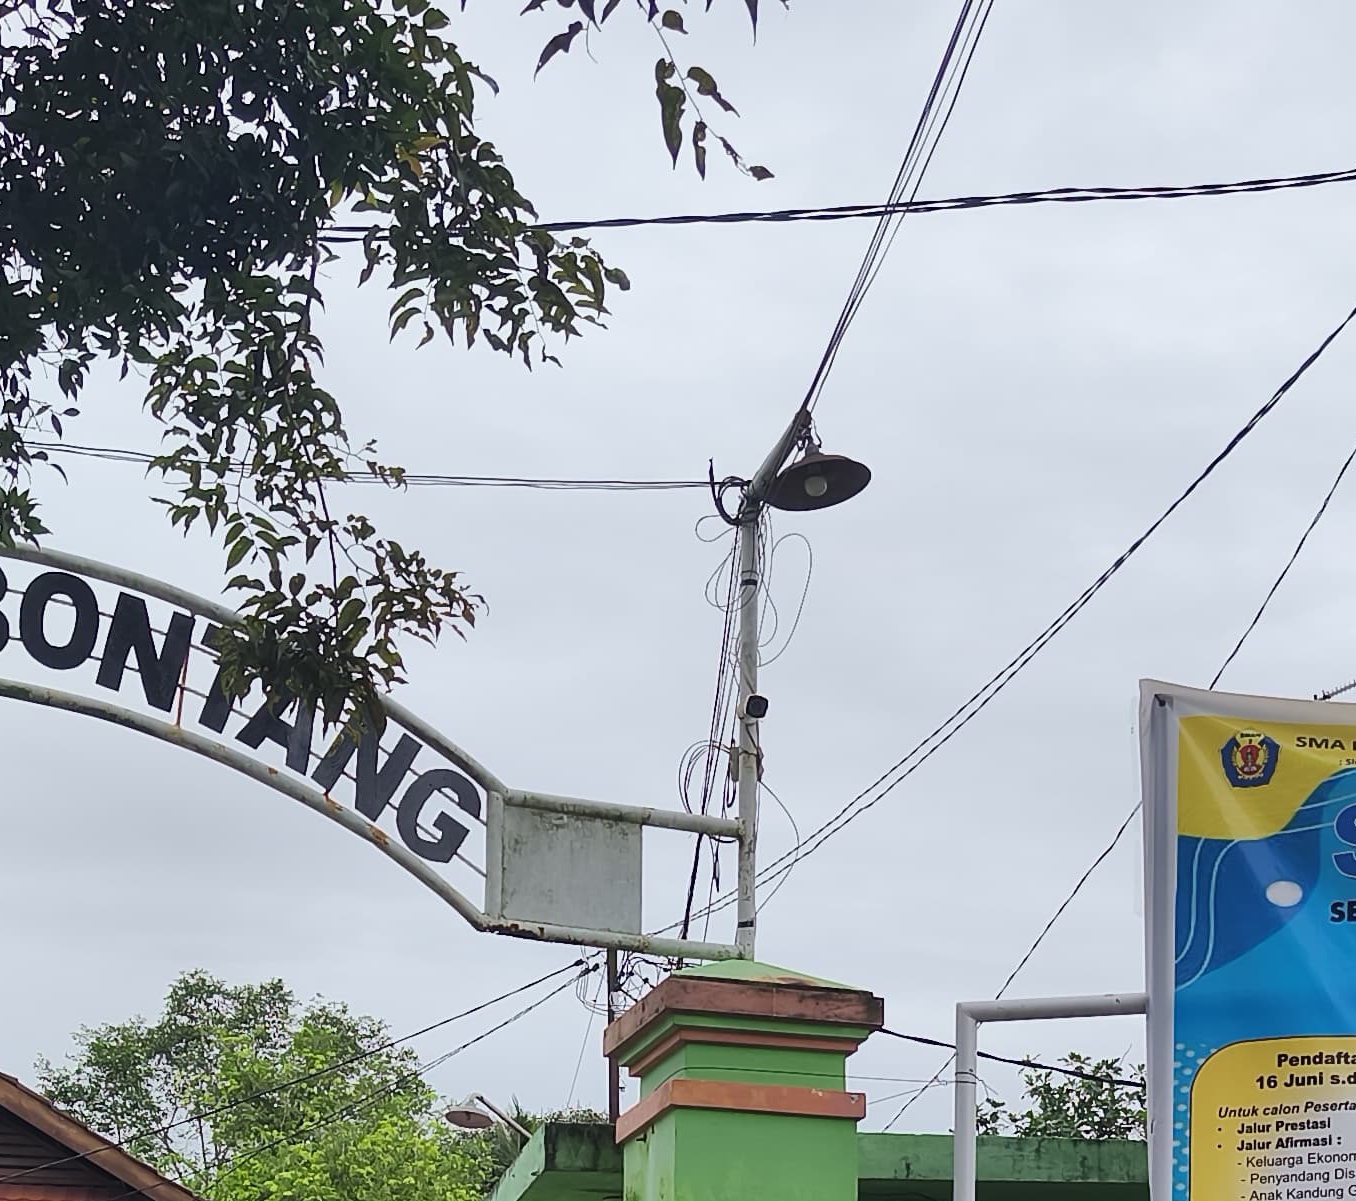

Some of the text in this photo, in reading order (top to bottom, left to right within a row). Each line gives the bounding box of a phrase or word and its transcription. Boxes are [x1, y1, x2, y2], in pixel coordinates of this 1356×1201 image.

[1295, 737, 1345, 750] SMA
[1256, 1075, 1277, 1089] 16
[1284, 1072, 1323, 1088] Juni
[1218, 1106, 1259, 1119] Untuk
[1263, 1103, 1299, 1116] calon
[1304, 1100, 1356, 1116] Peserta
[1237, 1118, 1331, 1134] Jalur Prestasi
[1237, 1134, 1332, 1151] Jalur Afirmasi
[1246, 1154, 1303, 1168] Keluarga
